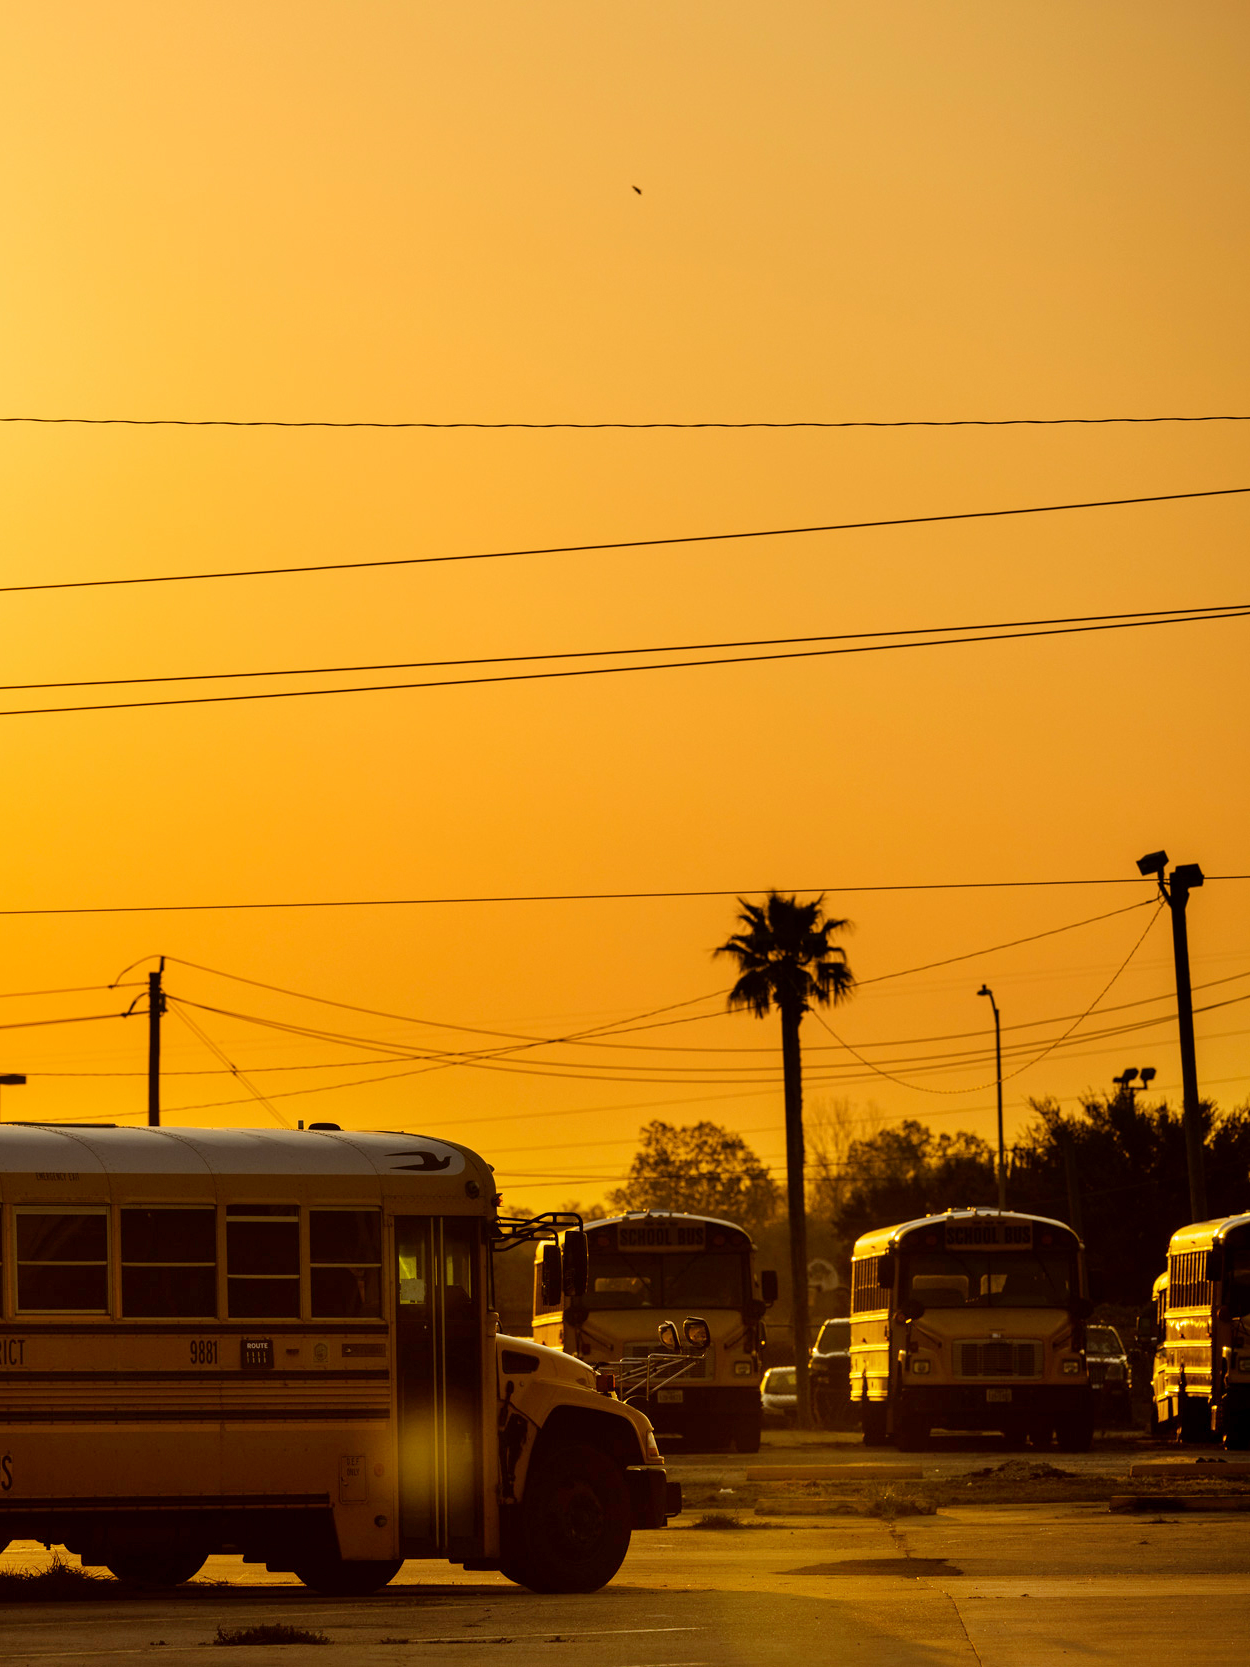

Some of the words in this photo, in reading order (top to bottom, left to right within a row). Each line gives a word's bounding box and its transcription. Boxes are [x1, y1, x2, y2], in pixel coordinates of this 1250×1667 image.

[619, 1227, 672, 1246] SCHOOL
[676, 1226, 704, 1245] BUS
[946, 1226, 999, 1245] SCHOOL
[1004, 1225, 1031, 1244] BUS
[189, 1339, 218, 1365] 9881
[346, 1468, 360, 1476] ONLY
